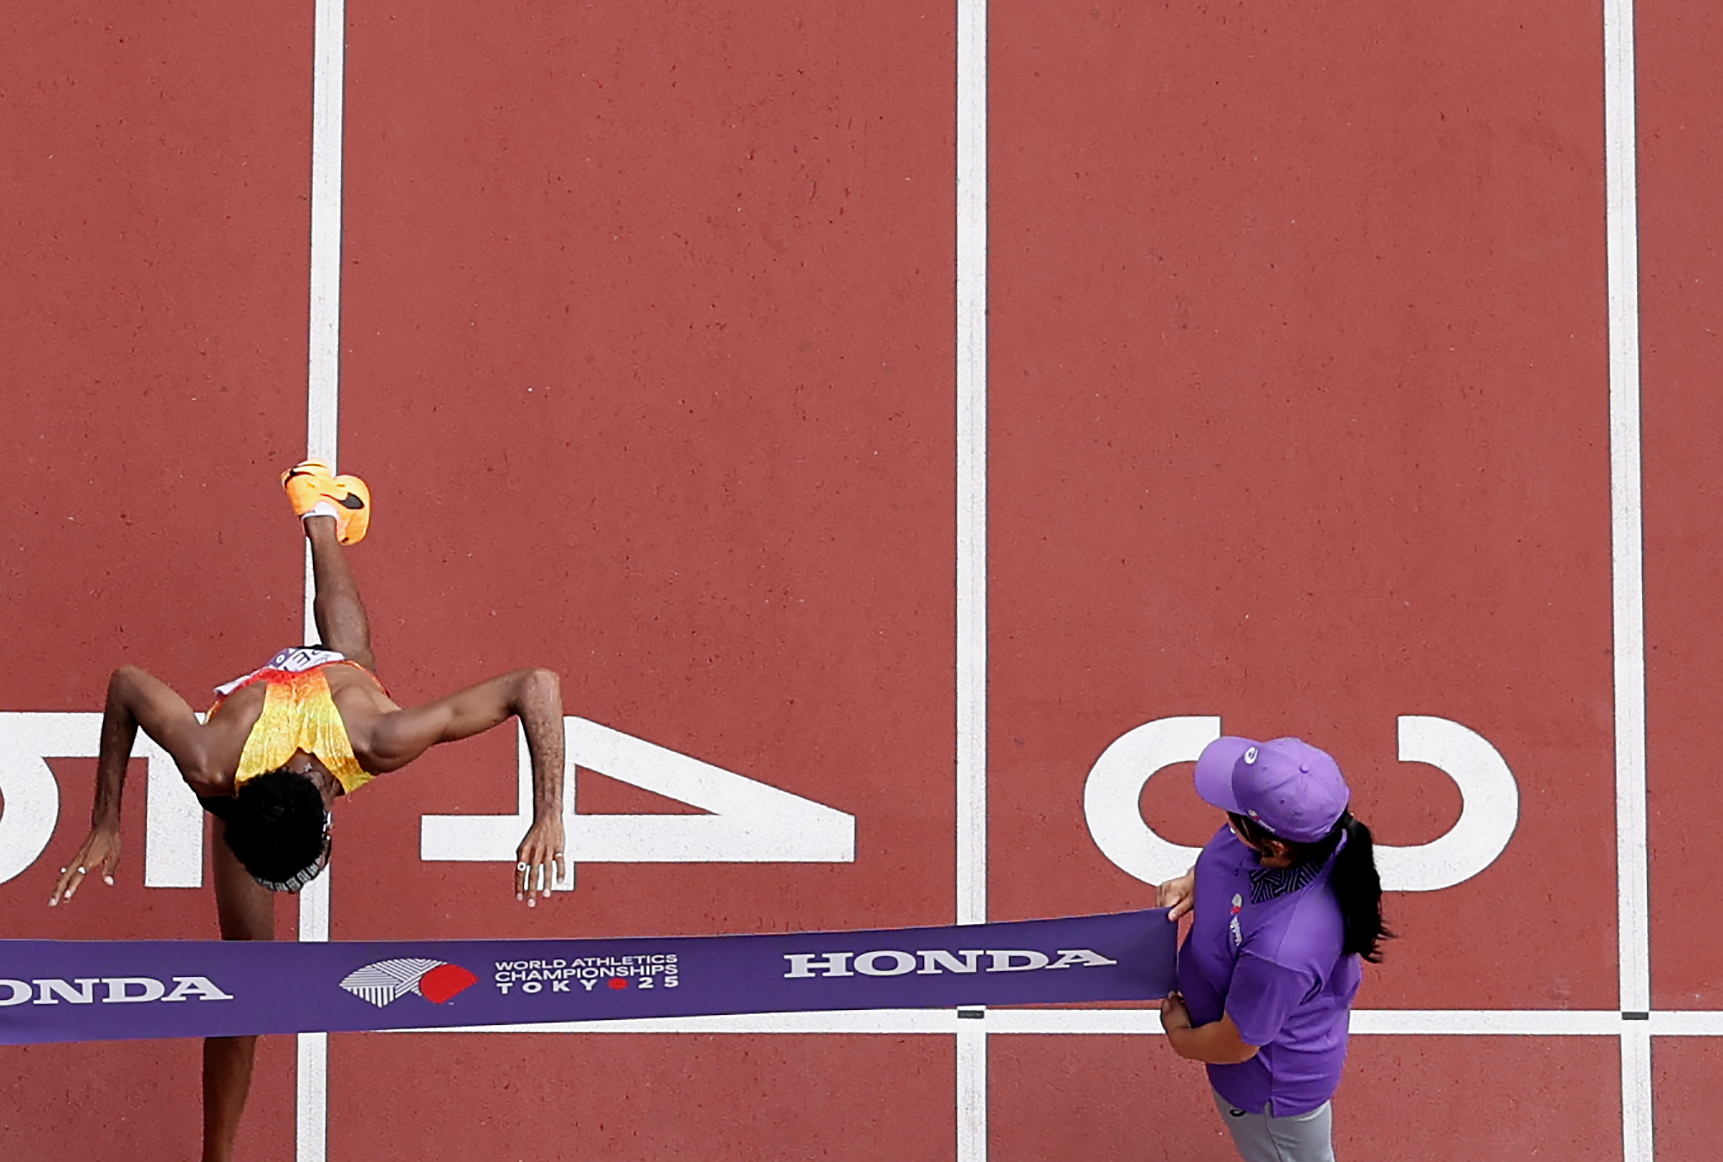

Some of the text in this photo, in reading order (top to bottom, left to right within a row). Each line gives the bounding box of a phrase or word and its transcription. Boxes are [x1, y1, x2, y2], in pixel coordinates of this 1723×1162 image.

[420, 716, 856, 892] 4
[1083, 715, 1520, 892] 3
[495, 954, 678, 971] WORLD ATHLETICS
[495, 964, 679, 982] CHAMPIONSHIPS
[783, 949, 1117, 979] HONDA
